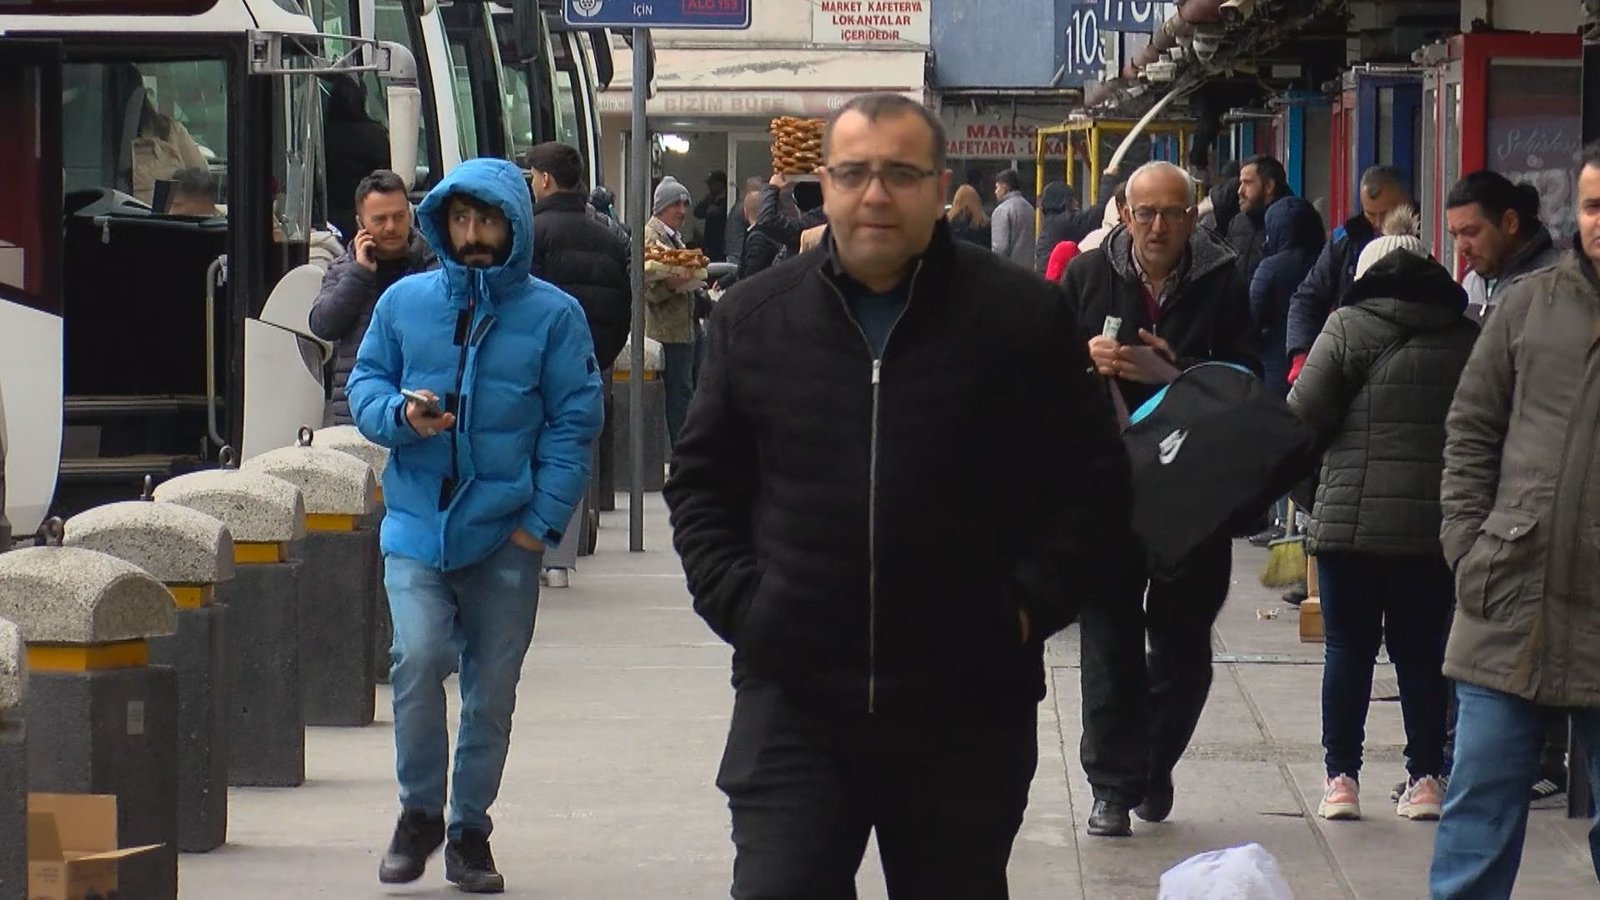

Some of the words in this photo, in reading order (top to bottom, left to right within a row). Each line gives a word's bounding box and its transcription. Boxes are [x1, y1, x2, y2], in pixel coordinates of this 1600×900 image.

[632, 4, 653, 17] İÇİN
[821, 2, 862, 12] MARKET
[867, 2, 922, 12] KAFETERYA
[832, 15, 911, 25] LOKANTALAR
[945, 140, 1015, 155] AFETARYA
